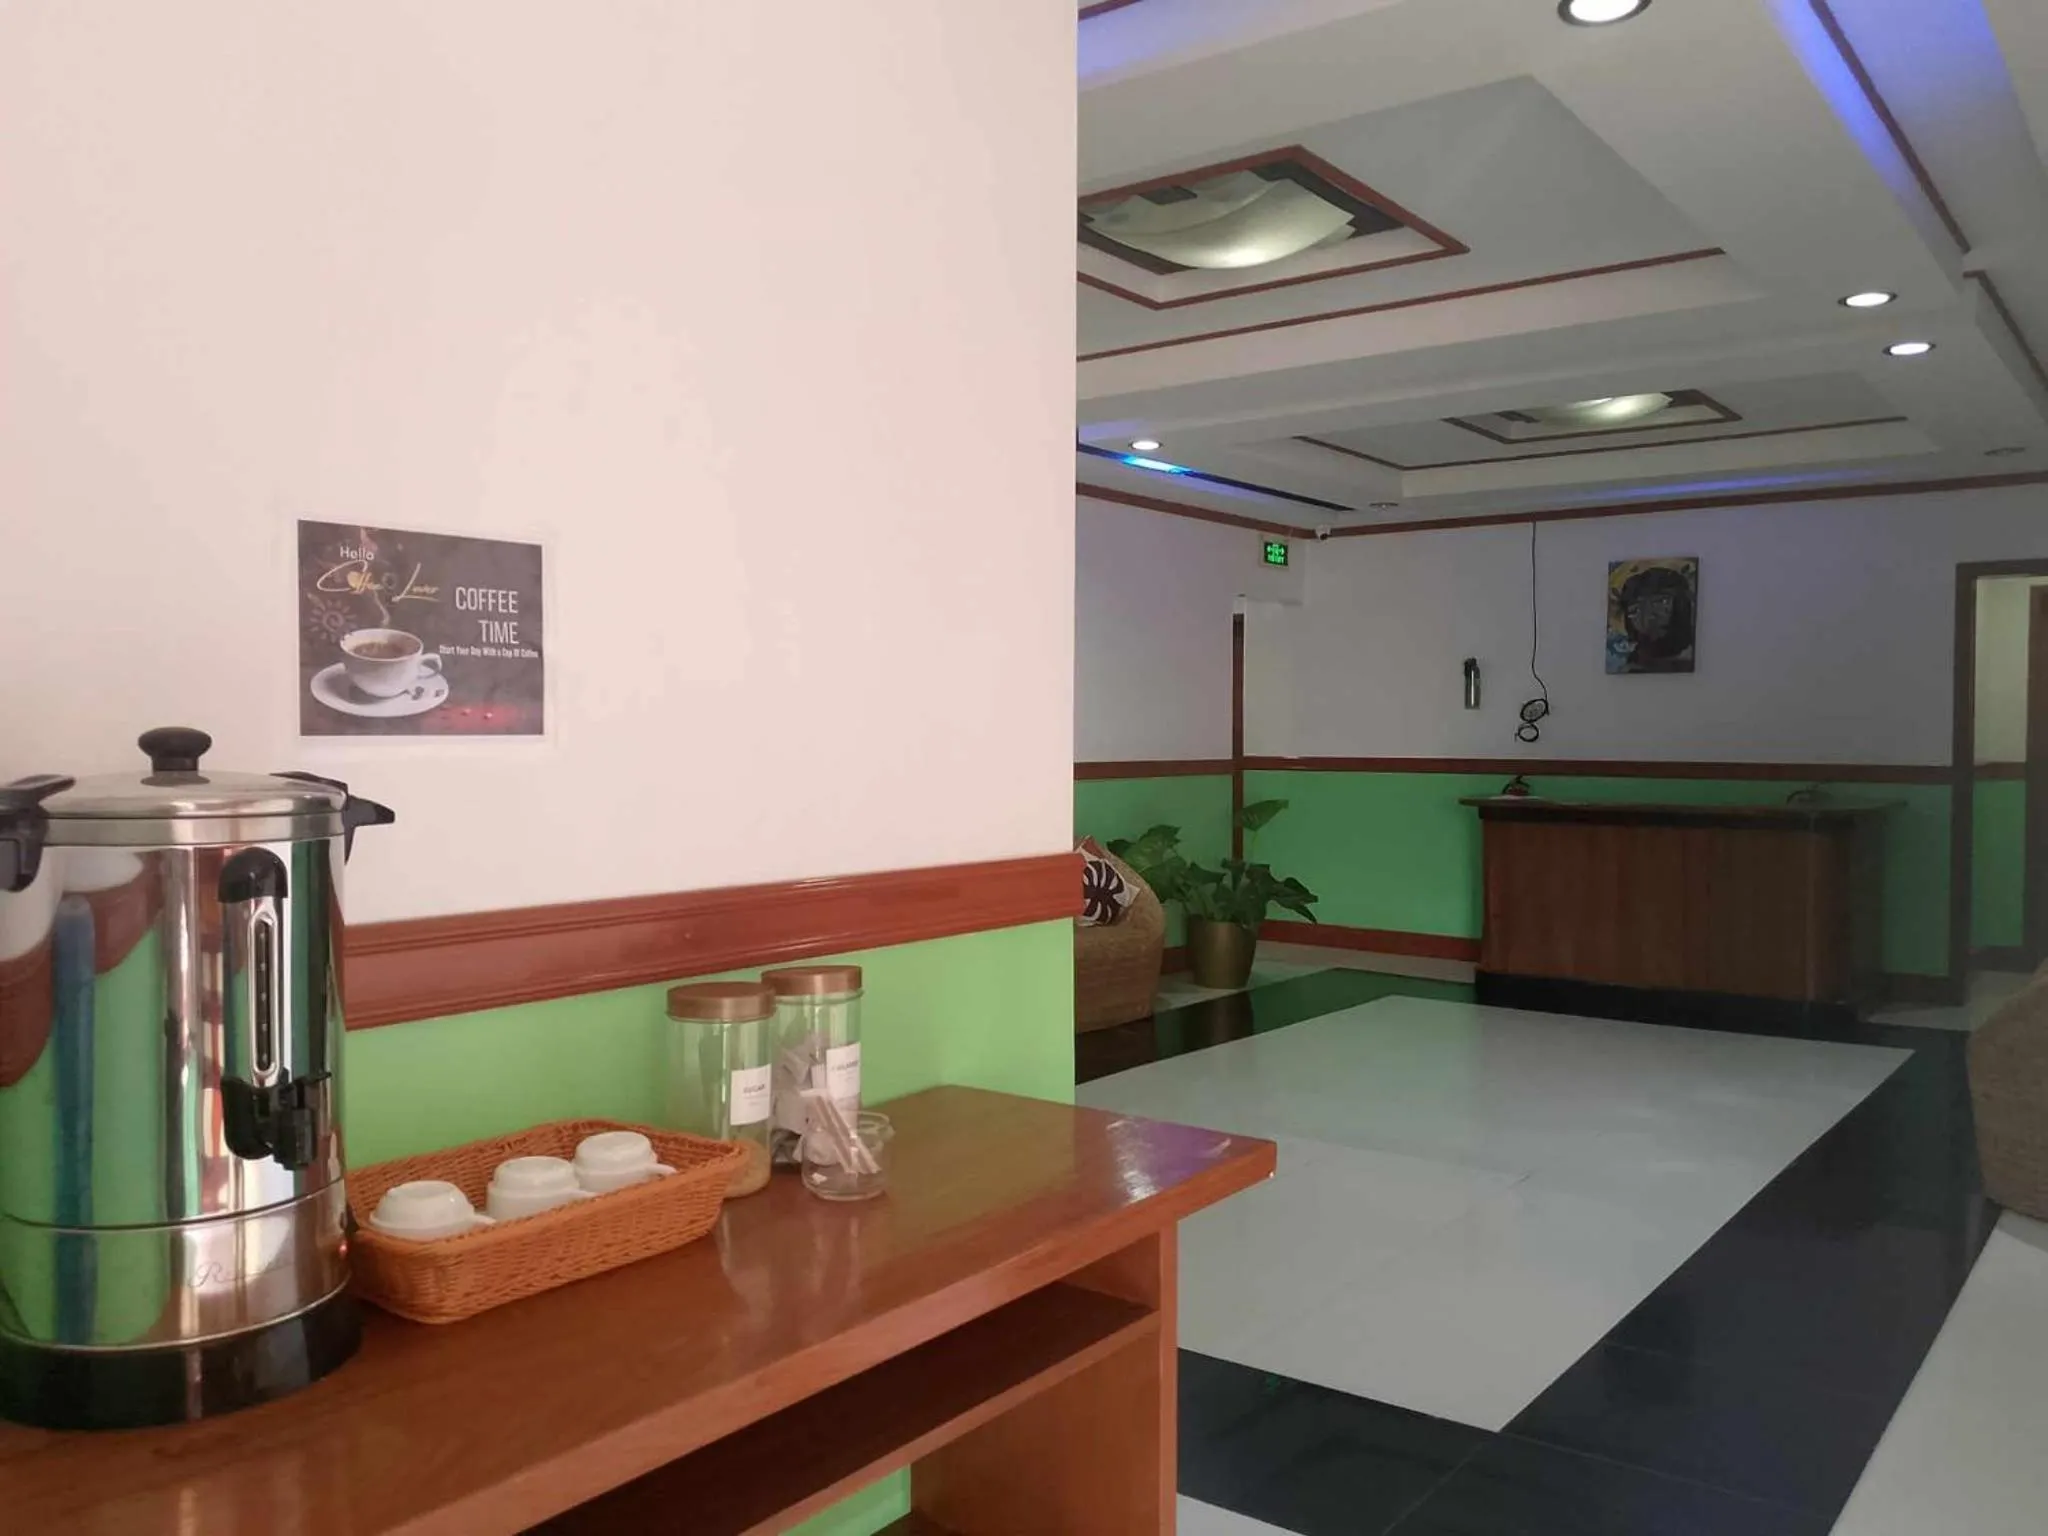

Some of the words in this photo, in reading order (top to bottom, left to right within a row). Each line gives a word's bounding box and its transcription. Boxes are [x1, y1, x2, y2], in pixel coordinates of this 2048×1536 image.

[340, 546, 374, 560] Hello
[455, 586, 518, 613] COFFEE
[479, 619, 519, 644] TIME
[439, 645, 455, 655] Start
[456, 646, 469, 656] Your
[470, 646, 481, 658] Day
[502, 647, 512, 658] Cup
[521, 648, 538, 658] Coffee
